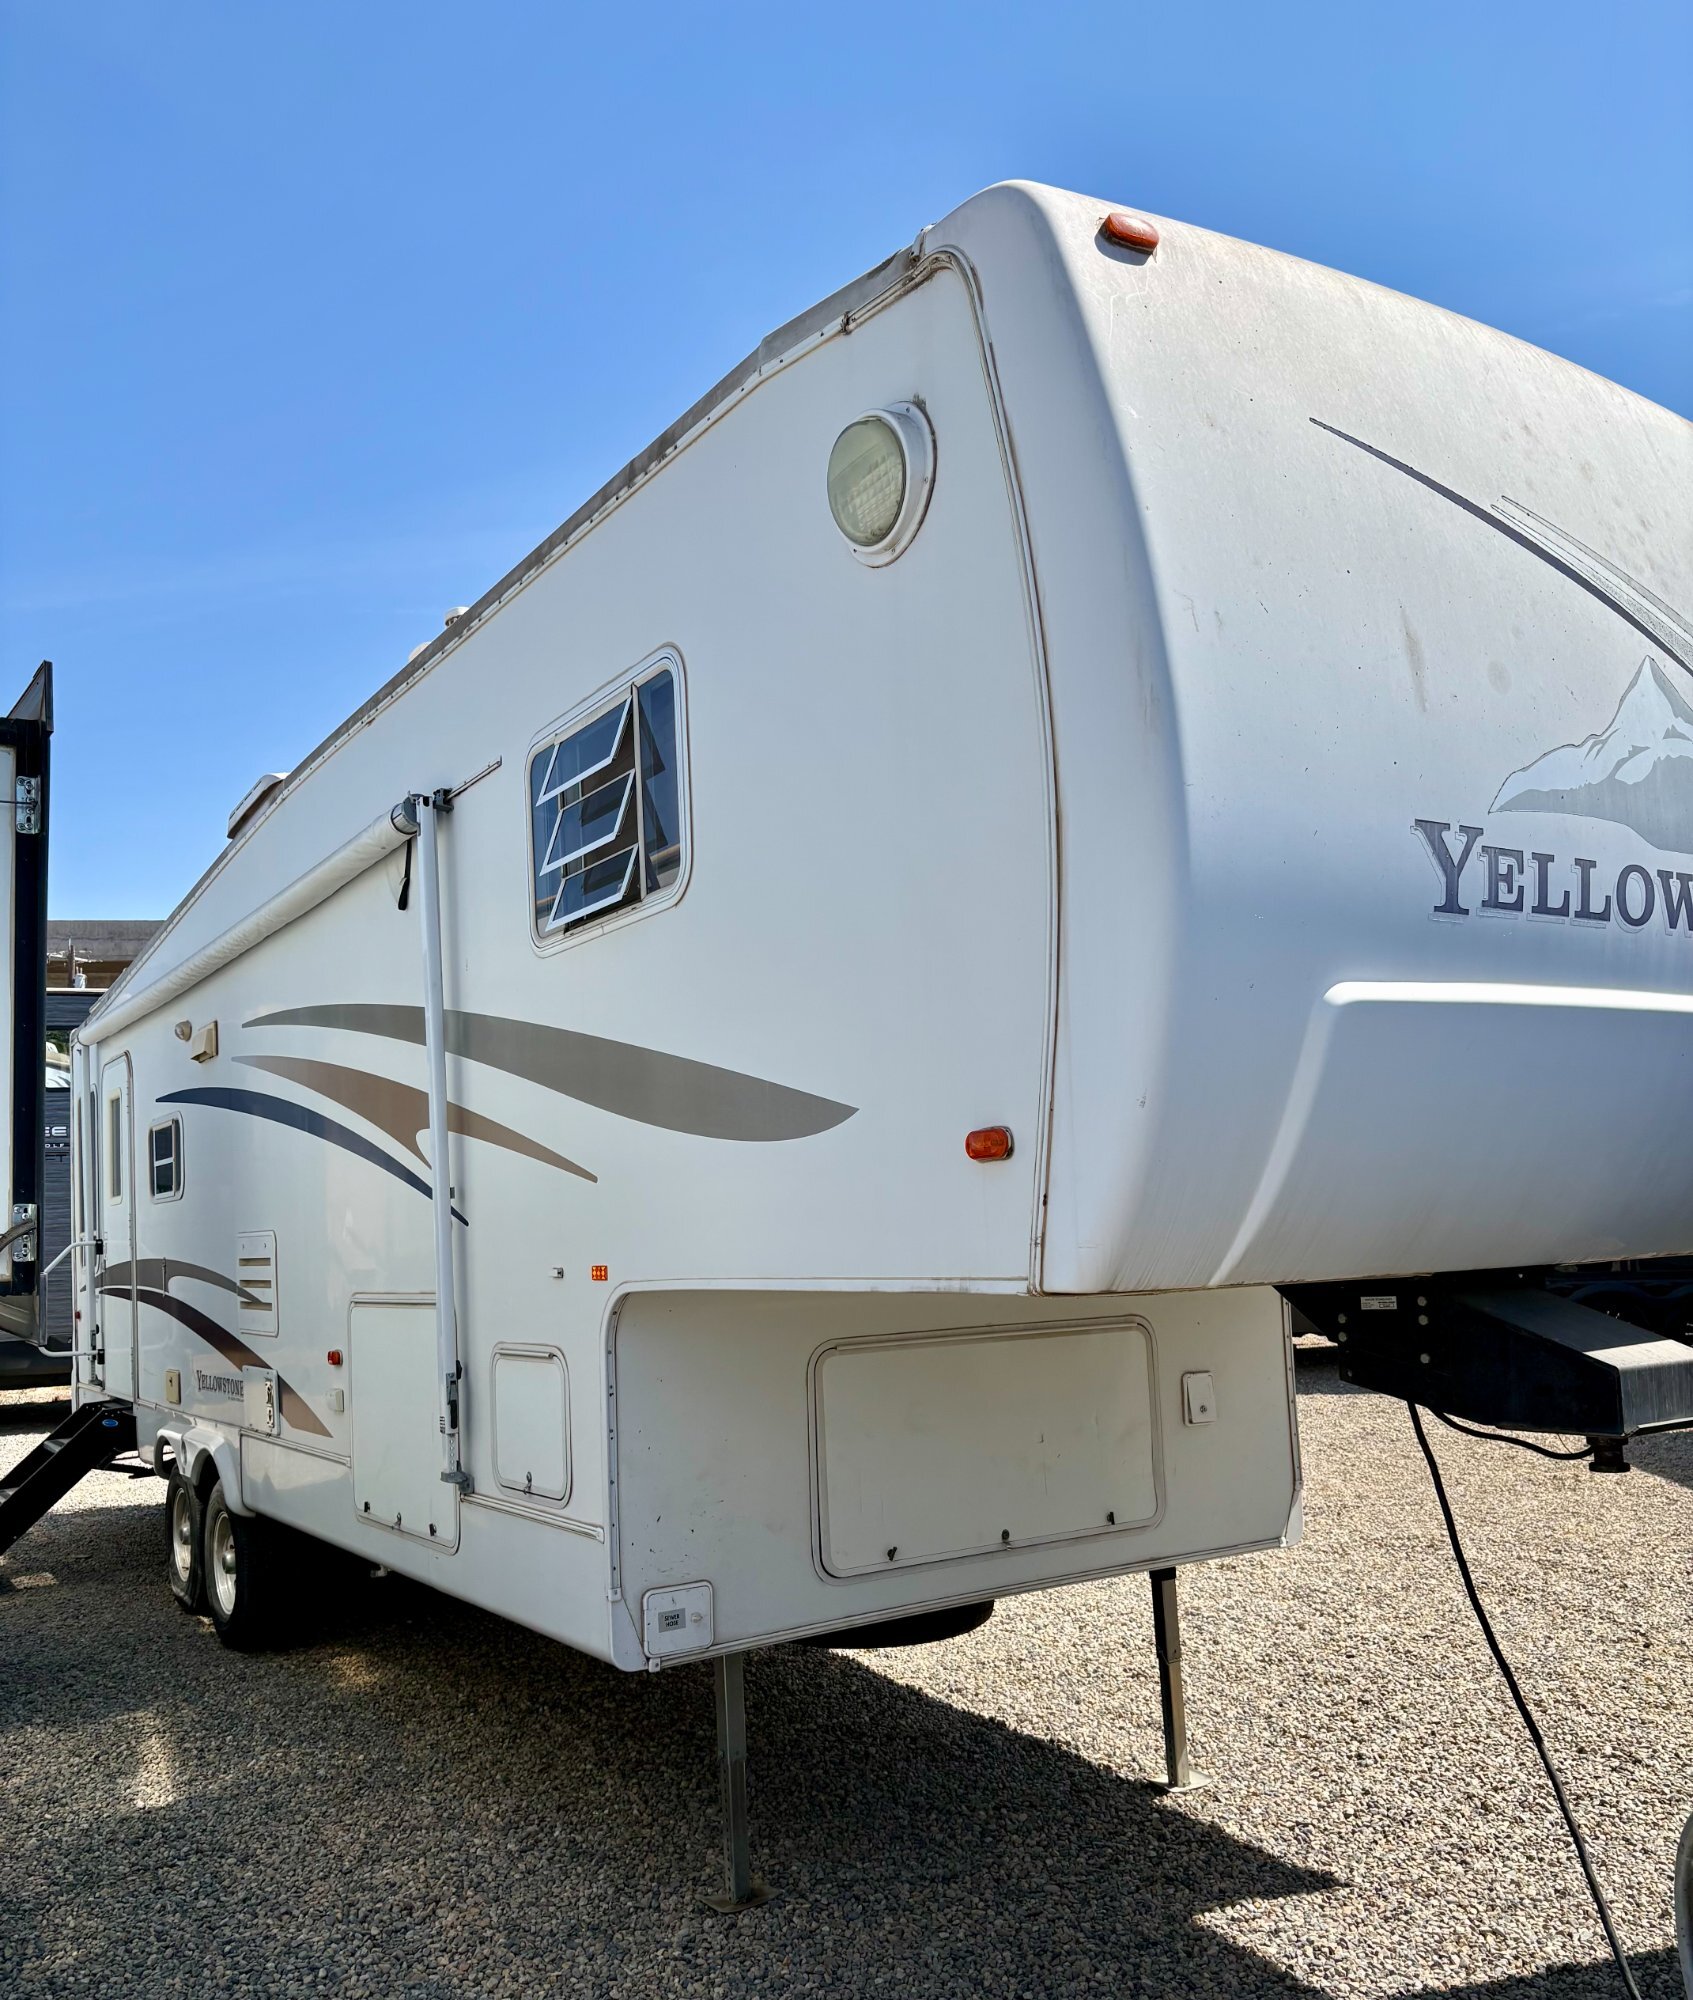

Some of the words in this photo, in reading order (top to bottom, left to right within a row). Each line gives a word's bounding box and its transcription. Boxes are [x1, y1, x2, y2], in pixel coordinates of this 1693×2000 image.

[1411, 818, 1693, 935] YELLOW
[196, 1370, 244, 1397] YELLOWSTONE
[664, 1613, 680, 1622] SEWER
[665, 1620, 679, 1628] HOSE
